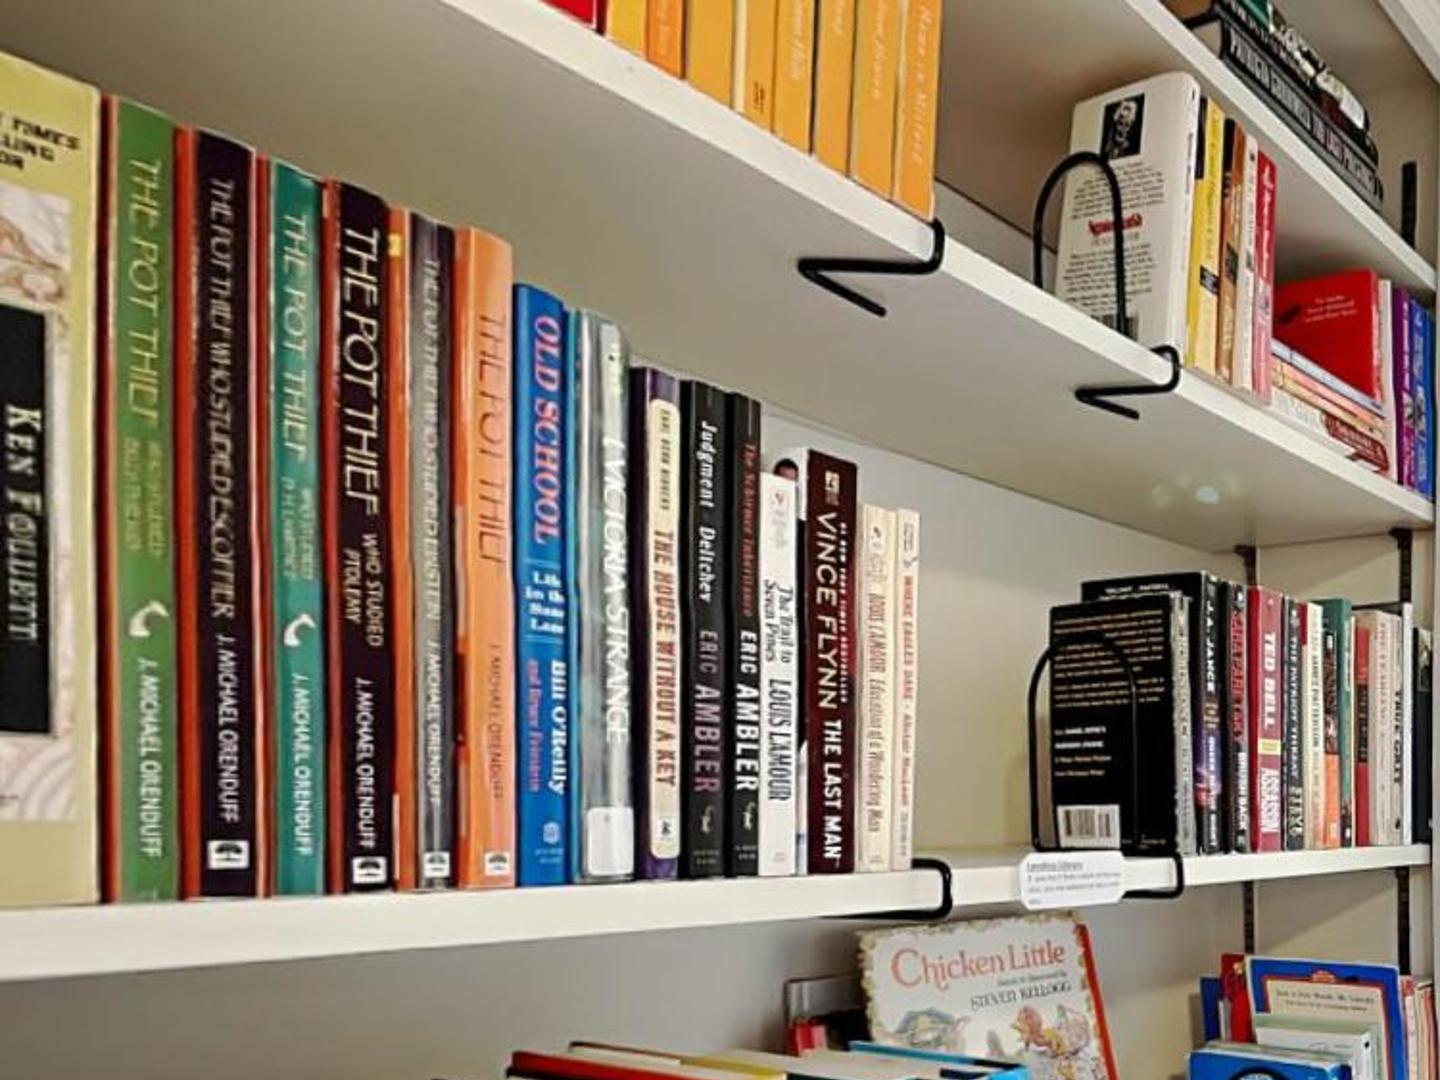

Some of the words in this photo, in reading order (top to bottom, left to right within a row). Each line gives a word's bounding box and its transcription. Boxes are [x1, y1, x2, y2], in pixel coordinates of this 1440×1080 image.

[128, 158, 163, 228] THE
[128, 235, 161, 320] POT
[210, 223, 234, 272] POT
[281, 212, 309, 279] THE
[343, 226, 381, 308] THE
[281, 285, 307, 364] POT
[343, 309, 379, 401] POT
[477, 313, 507, 385] THE
[533, 315, 560, 392] OLD
[128, 328, 162, 430] THIEF
[210, 342, 233, 394] WHO
[7, 404, 42, 475] KEN
[209, 393, 232, 494] STUDIED
[281, 370, 308, 466] THIEF
[479, 390, 507, 459] POT
[343, 405, 381, 518] THIEF
[532, 397, 561, 546] SCHOOL
[696, 420, 717, 509] Judgment
[362, 533, 382, 574] WHO
[479, 477, 507, 565] THIEF
[603, 455, 629, 593] VICTORIA
[653, 530, 675, 566] THE
[7, 488, 42, 641] FOLLETT
[343, 548, 362, 625] PTOLEMY
[697, 525, 717, 604] Deltchev
[815, 512, 838, 606] VINCE
[366, 579, 384, 647] STUDIED
[654, 569, 676, 635] HOUSE
[763, 579, 780, 621] Seven
[777, 586, 794, 612] The
[778, 614, 794, 647] Trail
[138, 658, 158, 674] J.
[216, 634, 236, 648] J.
[604, 603, 631, 746] STRANGE
[698, 629, 718, 675] ERIC
[739, 629, 758, 675] ERIC
[764, 622, 779, 663] Pines
[780, 650, 792, 664] to
[816, 614, 839, 710] FLYNN
[1206, 636, 1216, 694] JANCE
[1263, 631, 1277, 671] TED
[1289, 636, 1299, 661] THE
[217, 649, 239, 726] MICHAEL
[291, 672, 310, 686] J.
[355, 677, 371, 690] J.
[427, 653, 442, 722] MICHAEL
[551, 660, 567, 700] Bill
[655, 640, 677, 726] WITHOUT
[768, 678, 792, 728] LOUIS
[1263, 677, 1277, 731] BELL
[139, 674, 161, 757] MICHAEL
[293, 688, 312, 762] MICHAEL
[355, 691, 373, 762] MICHAEL
[547, 705, 567, 796] O'Reilly
[656, 728, 676, 745] A
[693, 683, 721, 793] AMBLER
[735, 683, 760, 792] AMBLER
[823, 719, 843, 755] THE
[217, 729, 240, 824] ORENDUFF
[428, 722, 442, 807] ORENDUFF
[655, 749, 678, 788] KEY
[768, 731, 792, 801] L'AMOUR
[823, 762, 843, 810] LAST
[1290, 726, 1299, 779] THREAT
[139, 759, 162, 858] ORENDUFF
[293, 765, 313, 857] ORENDUFF
[356, 763, 375, 849] ORENDUFF
[1259, 767, 1281, 833] ASSASSIN
[822, 815, 842, 860] MAN
[890, 944, 1007, 992] Chicken
[1007, 940, 1065, 970] Little
